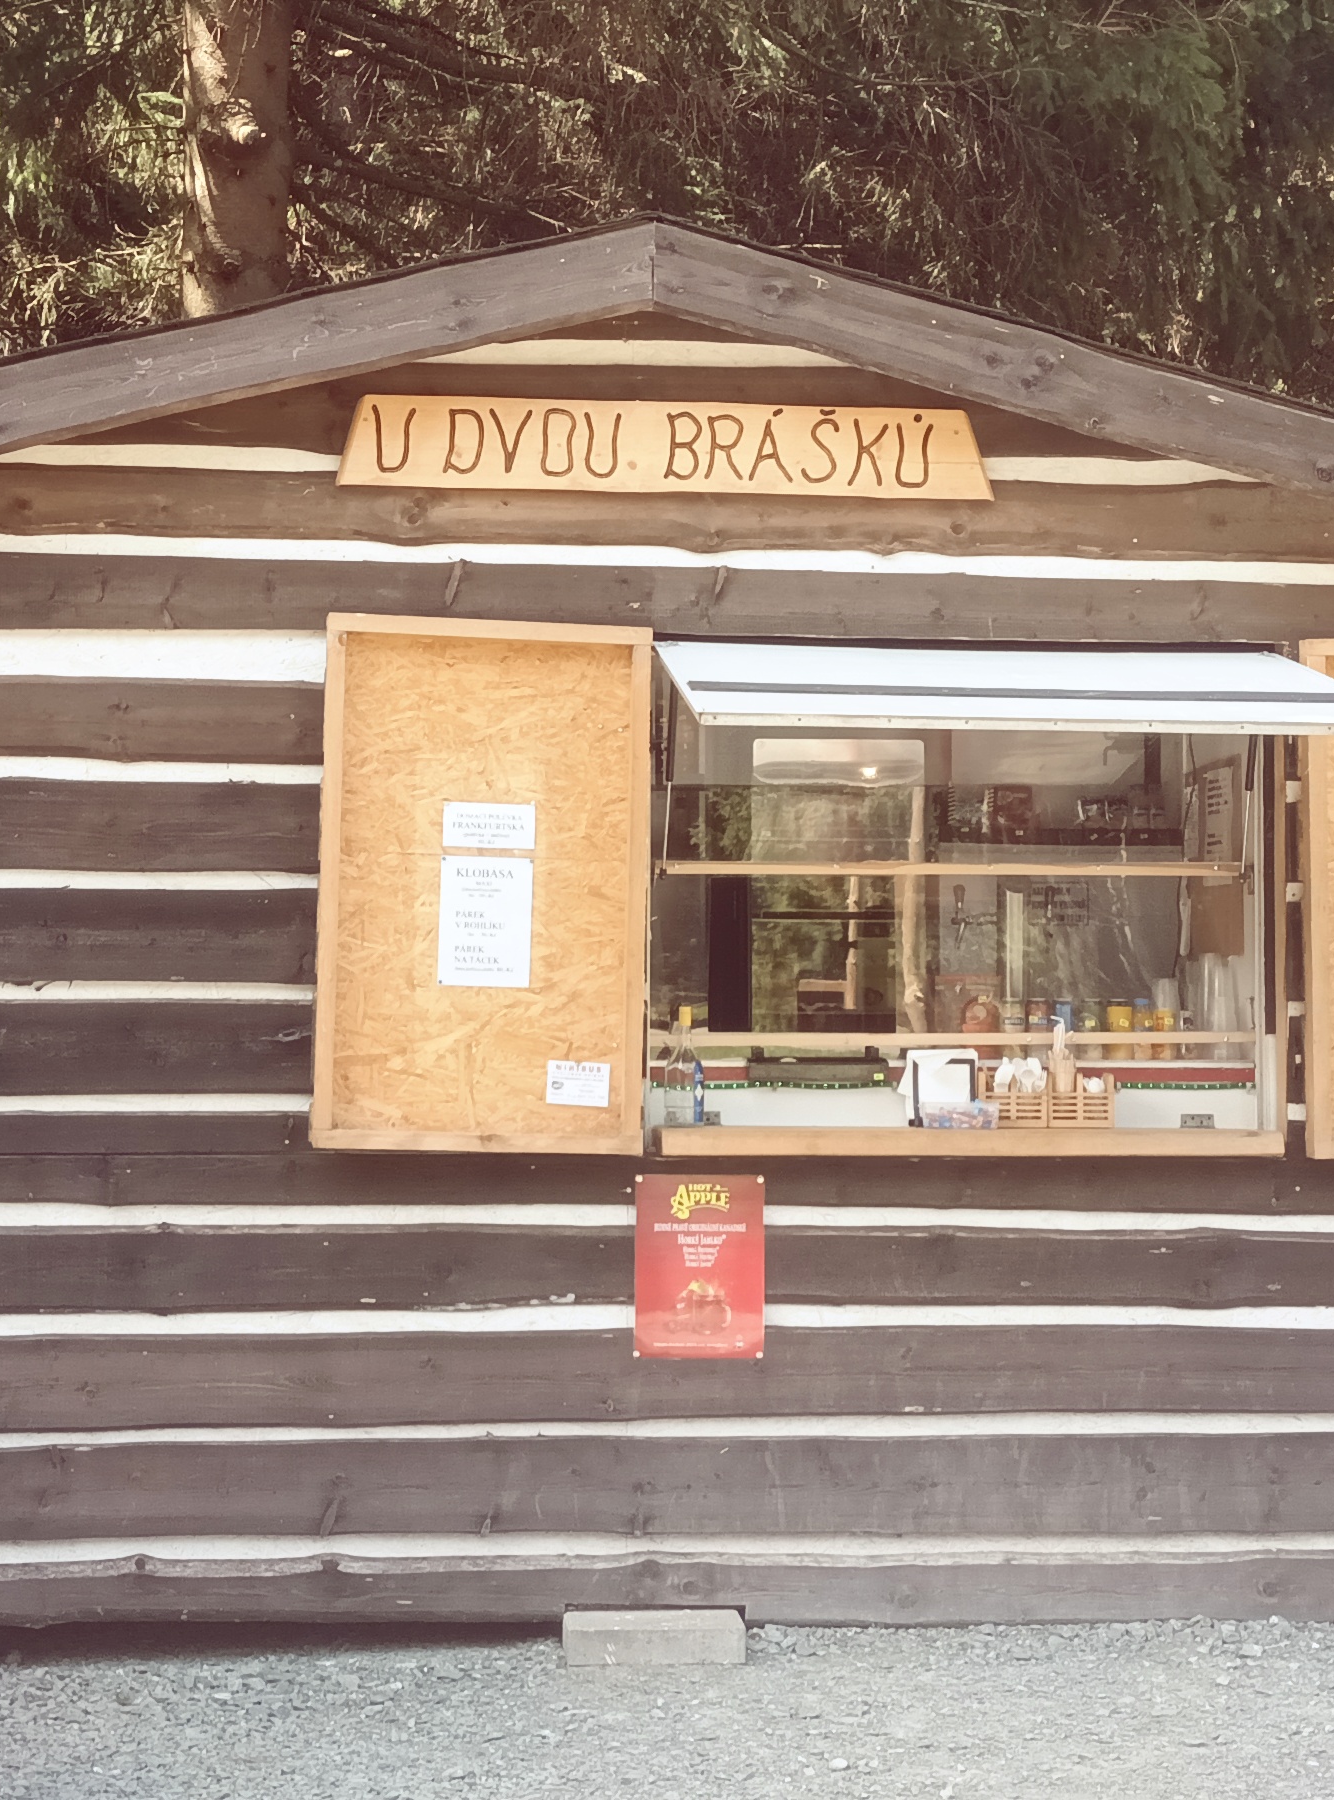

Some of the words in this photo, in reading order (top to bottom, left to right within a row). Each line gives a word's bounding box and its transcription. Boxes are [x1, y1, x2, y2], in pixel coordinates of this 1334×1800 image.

[371, 403, 417, 473] U
[442, 407, 623, 478] DVOU
[663, 408, 935, 489] BRÁŠKŮ
[670, 1184, 730, 1220] APPLE
